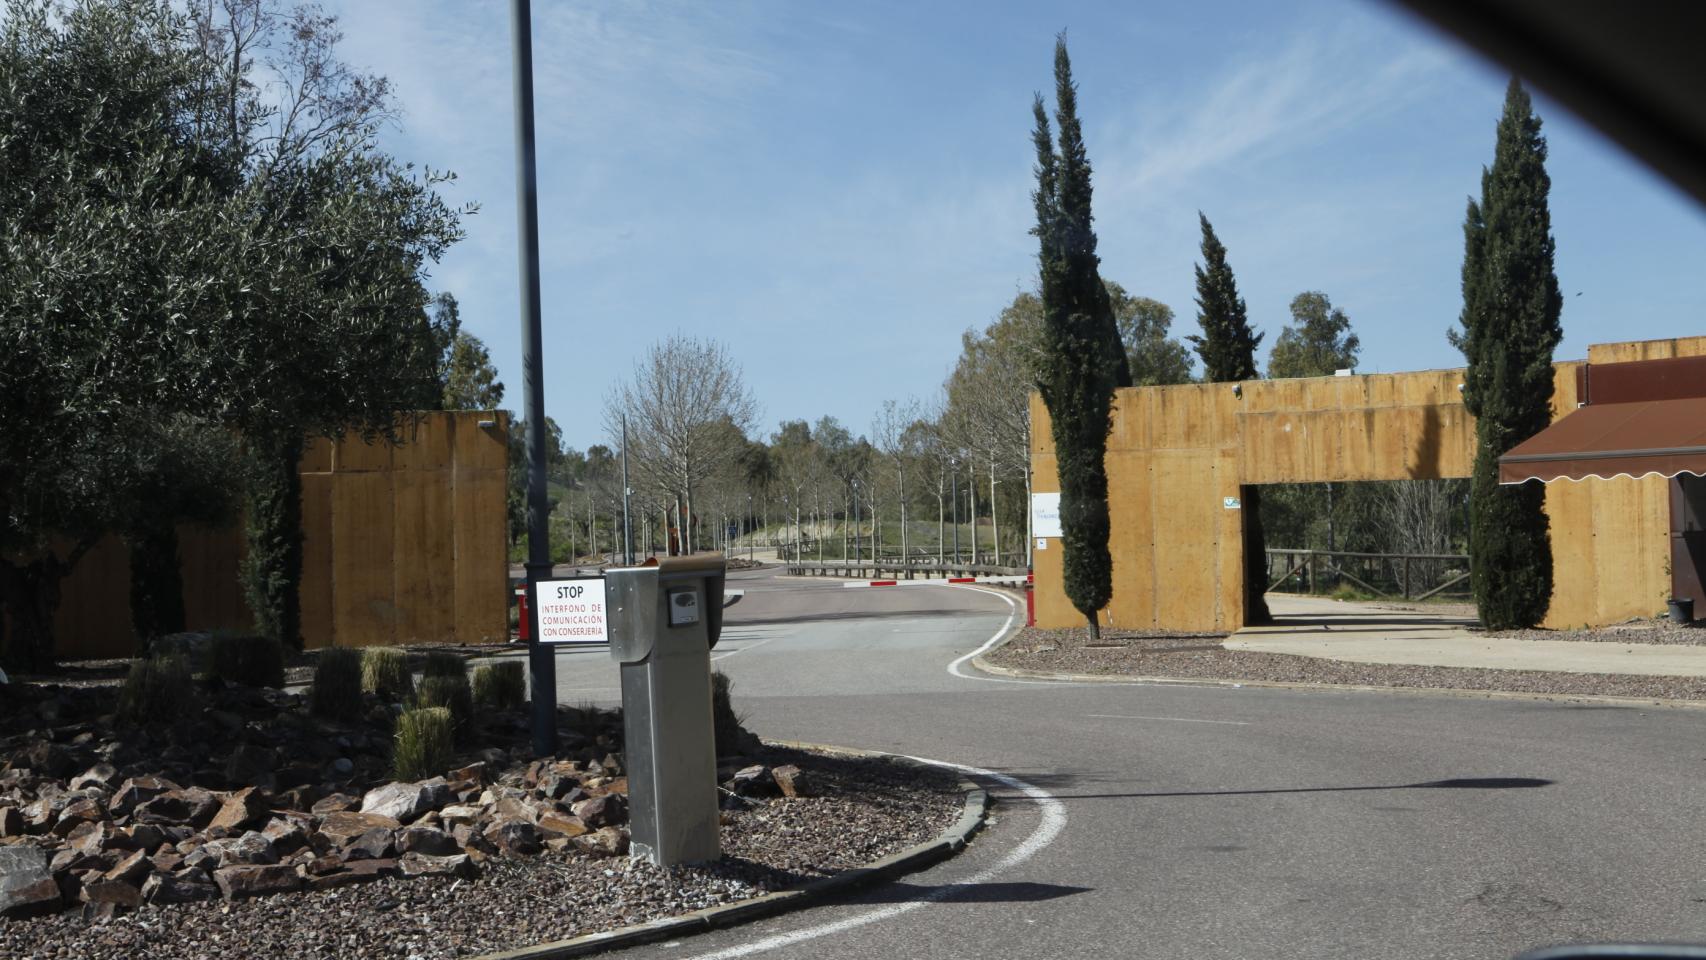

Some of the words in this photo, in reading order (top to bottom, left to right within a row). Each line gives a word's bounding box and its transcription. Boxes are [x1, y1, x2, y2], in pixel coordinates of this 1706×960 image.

[557, 586, 584, 599] STOP
[542, 604, 586, 613] INTERFONO
[591, 603, 602, 613] DE
[543, 628, 558, 637] CON
